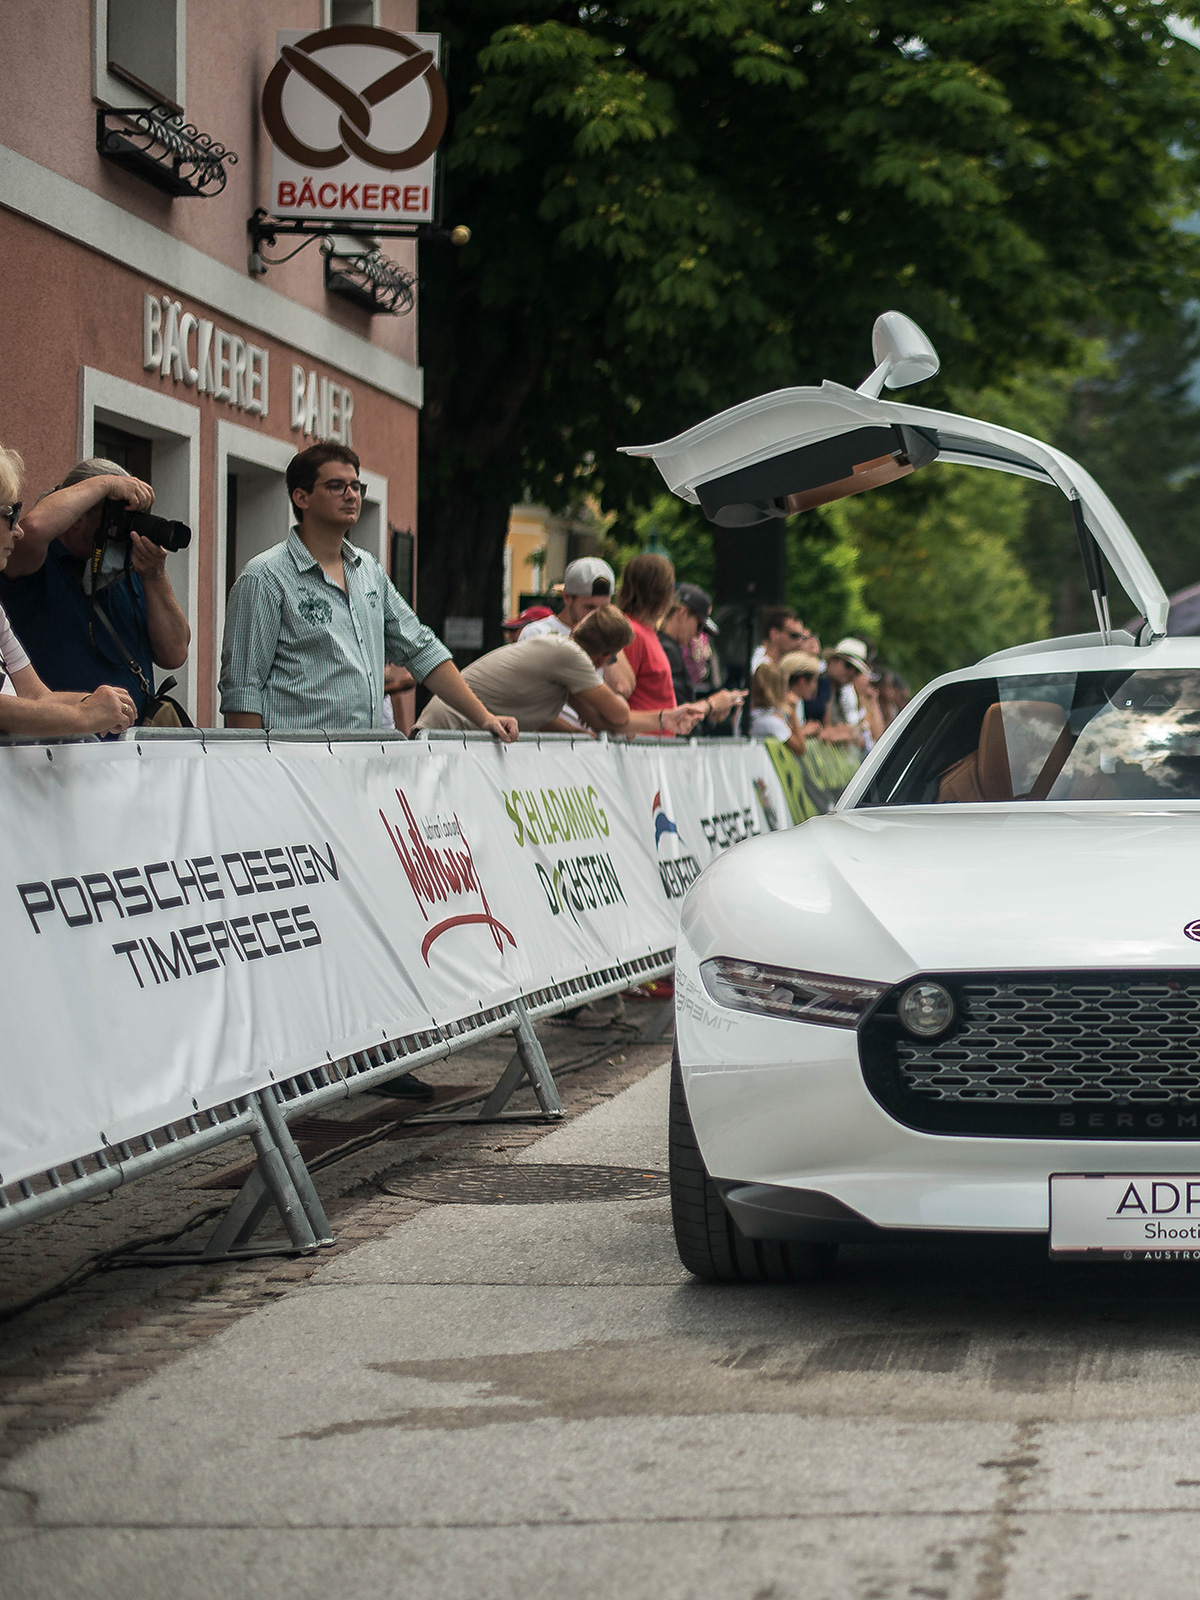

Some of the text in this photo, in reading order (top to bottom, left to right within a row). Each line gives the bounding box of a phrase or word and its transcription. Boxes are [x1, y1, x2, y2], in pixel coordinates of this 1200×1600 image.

[277, 176, 430, 212] BÄCKEREI
[143, 292, 355, 447] BÄCKEREI BAIER
[92, 548, 102, 573] Nikon
[501, 784, 610, 847] SCHLADMING
[16, 841, 340, 934] PORSCHE DESIGN
[111, 904, 322, 989] TIMEPIECES
